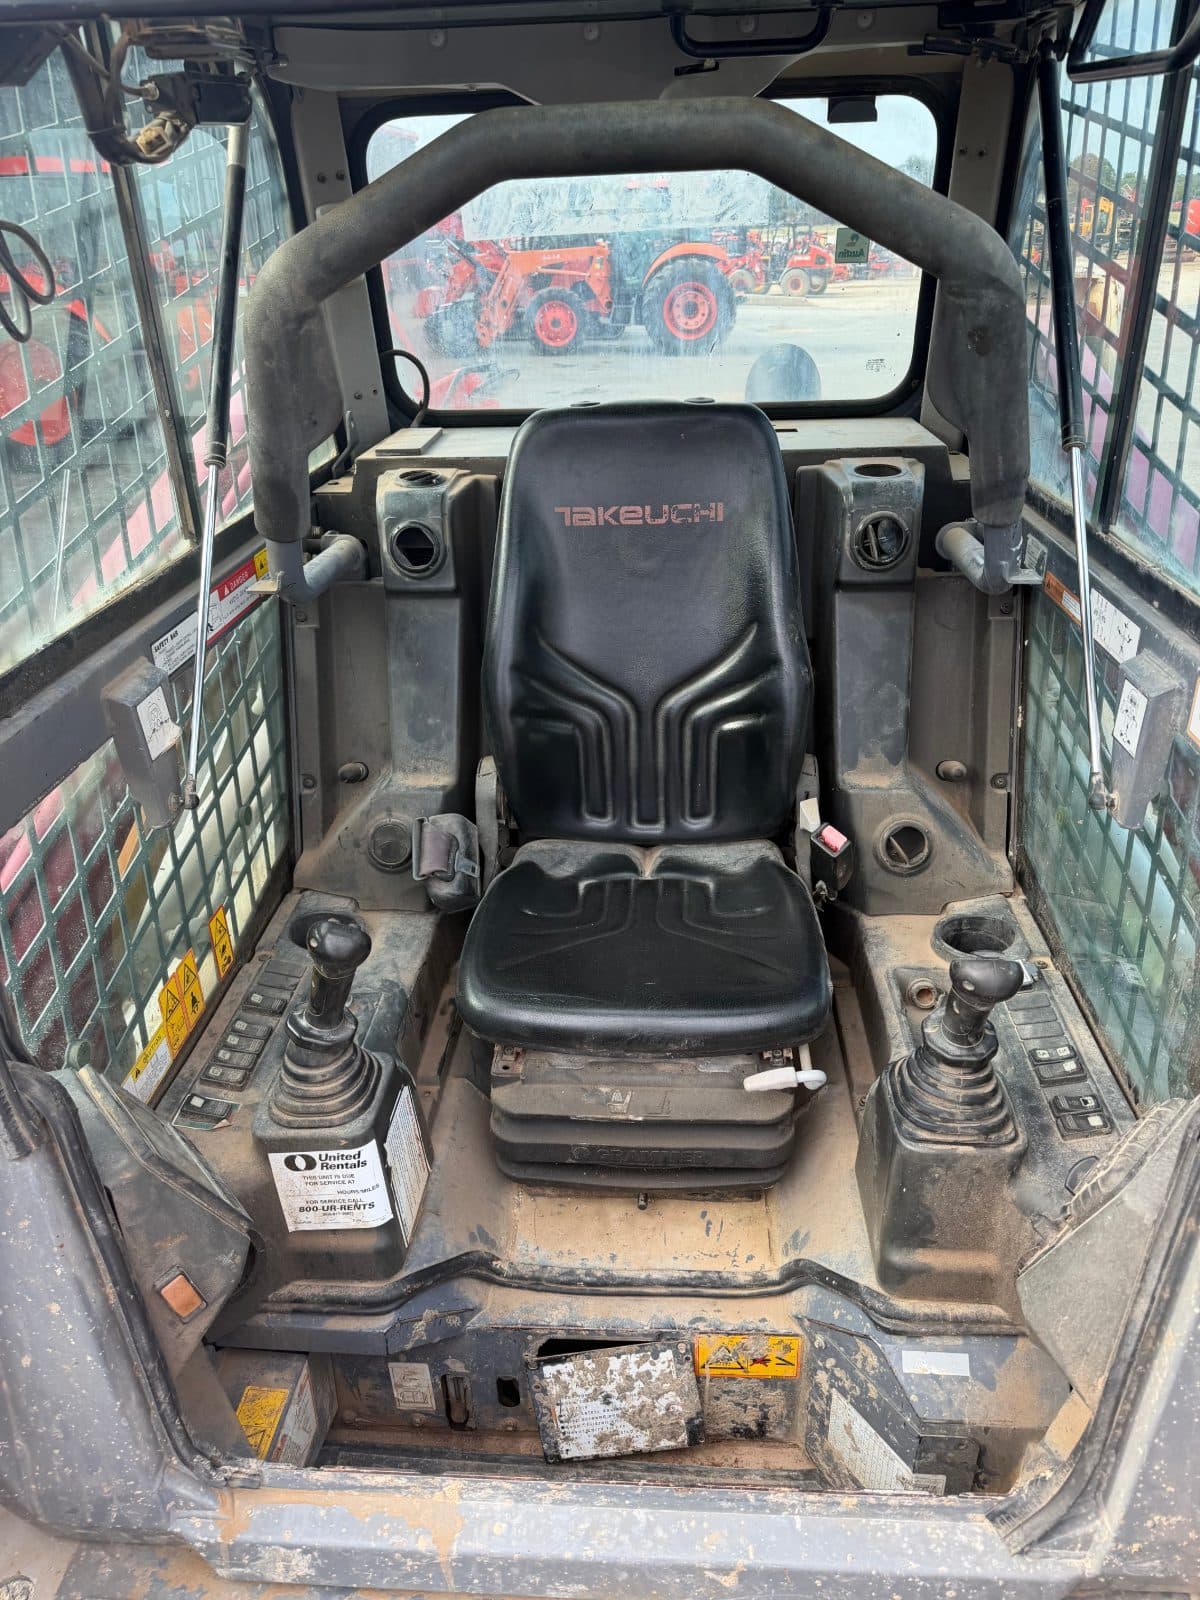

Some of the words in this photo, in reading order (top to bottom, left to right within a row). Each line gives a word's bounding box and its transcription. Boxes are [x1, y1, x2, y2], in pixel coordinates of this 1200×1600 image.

[154, 636, 169, 652] SAFETY
[319, 1151, 361, 1162] United
[320, 1159, 368, 1171] Rentals
[299, 1201, 375, 1213] 800-UR-RENTS
